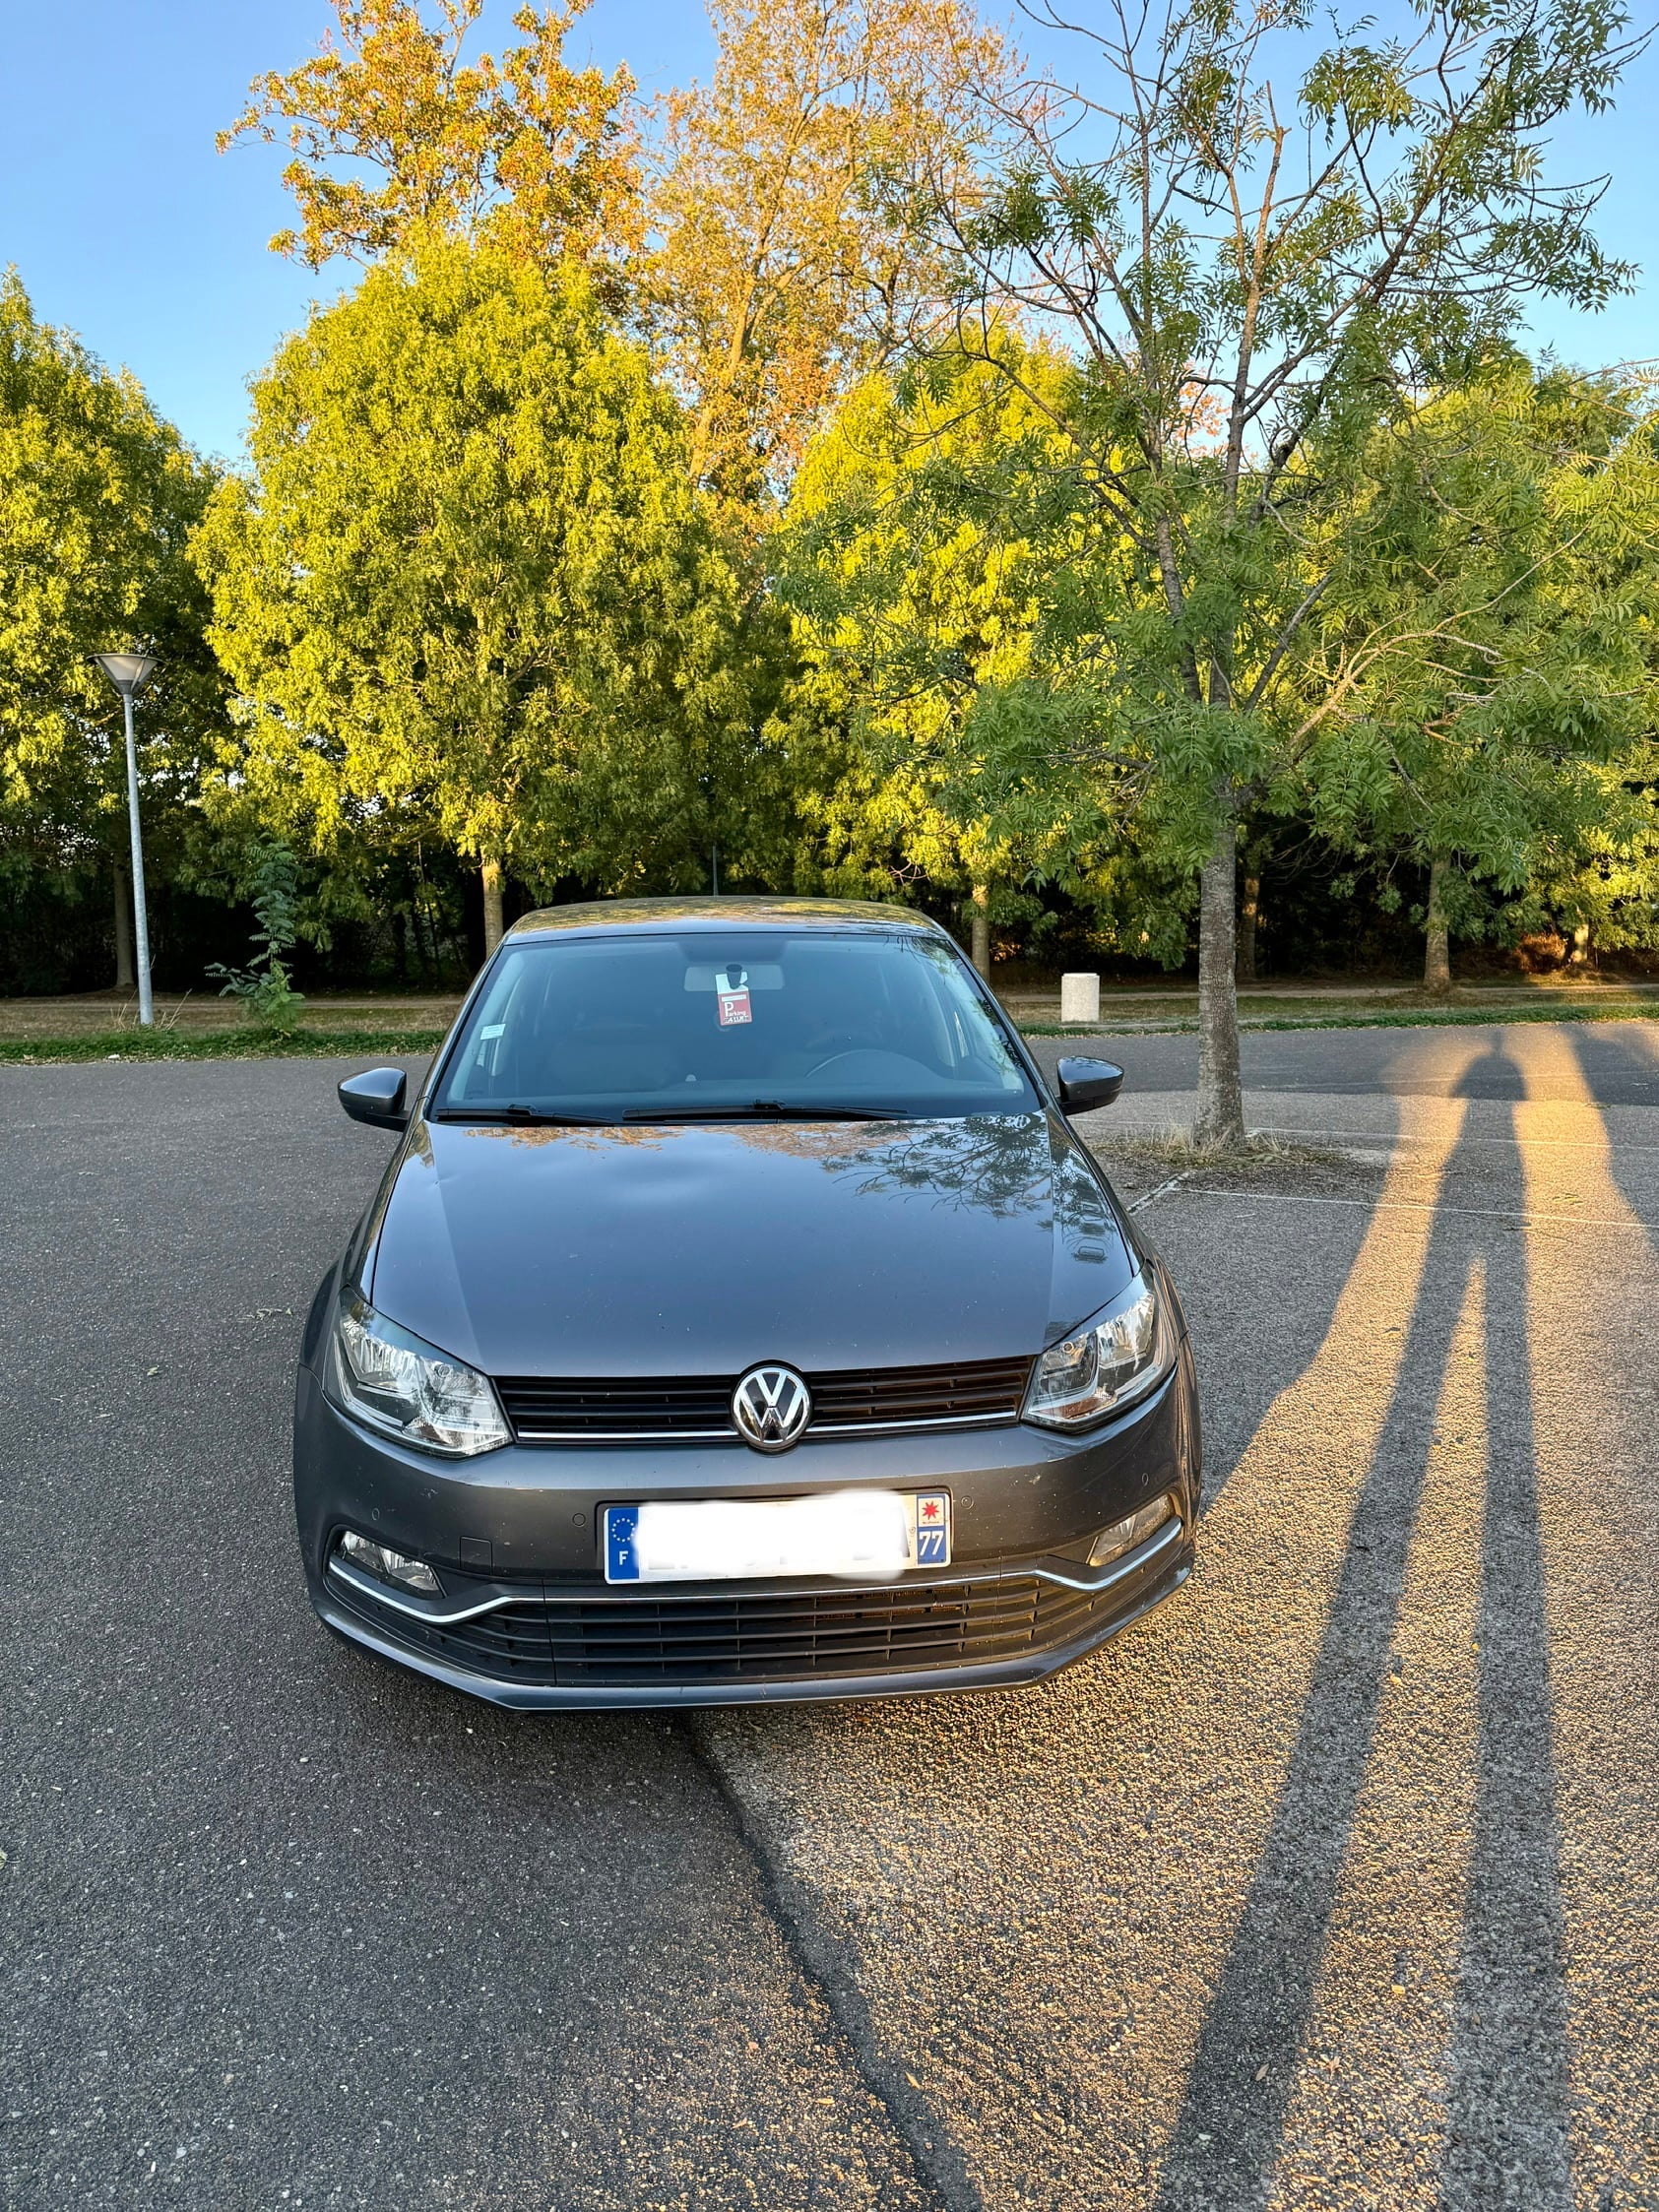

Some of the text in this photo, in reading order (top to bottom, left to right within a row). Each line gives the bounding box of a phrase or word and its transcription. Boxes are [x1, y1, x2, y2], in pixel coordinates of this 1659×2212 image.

[734, 1368, 809, 1443] VW
[919, 1530, 944, 1556] 77
[618, 1550, 629, 1566] F
